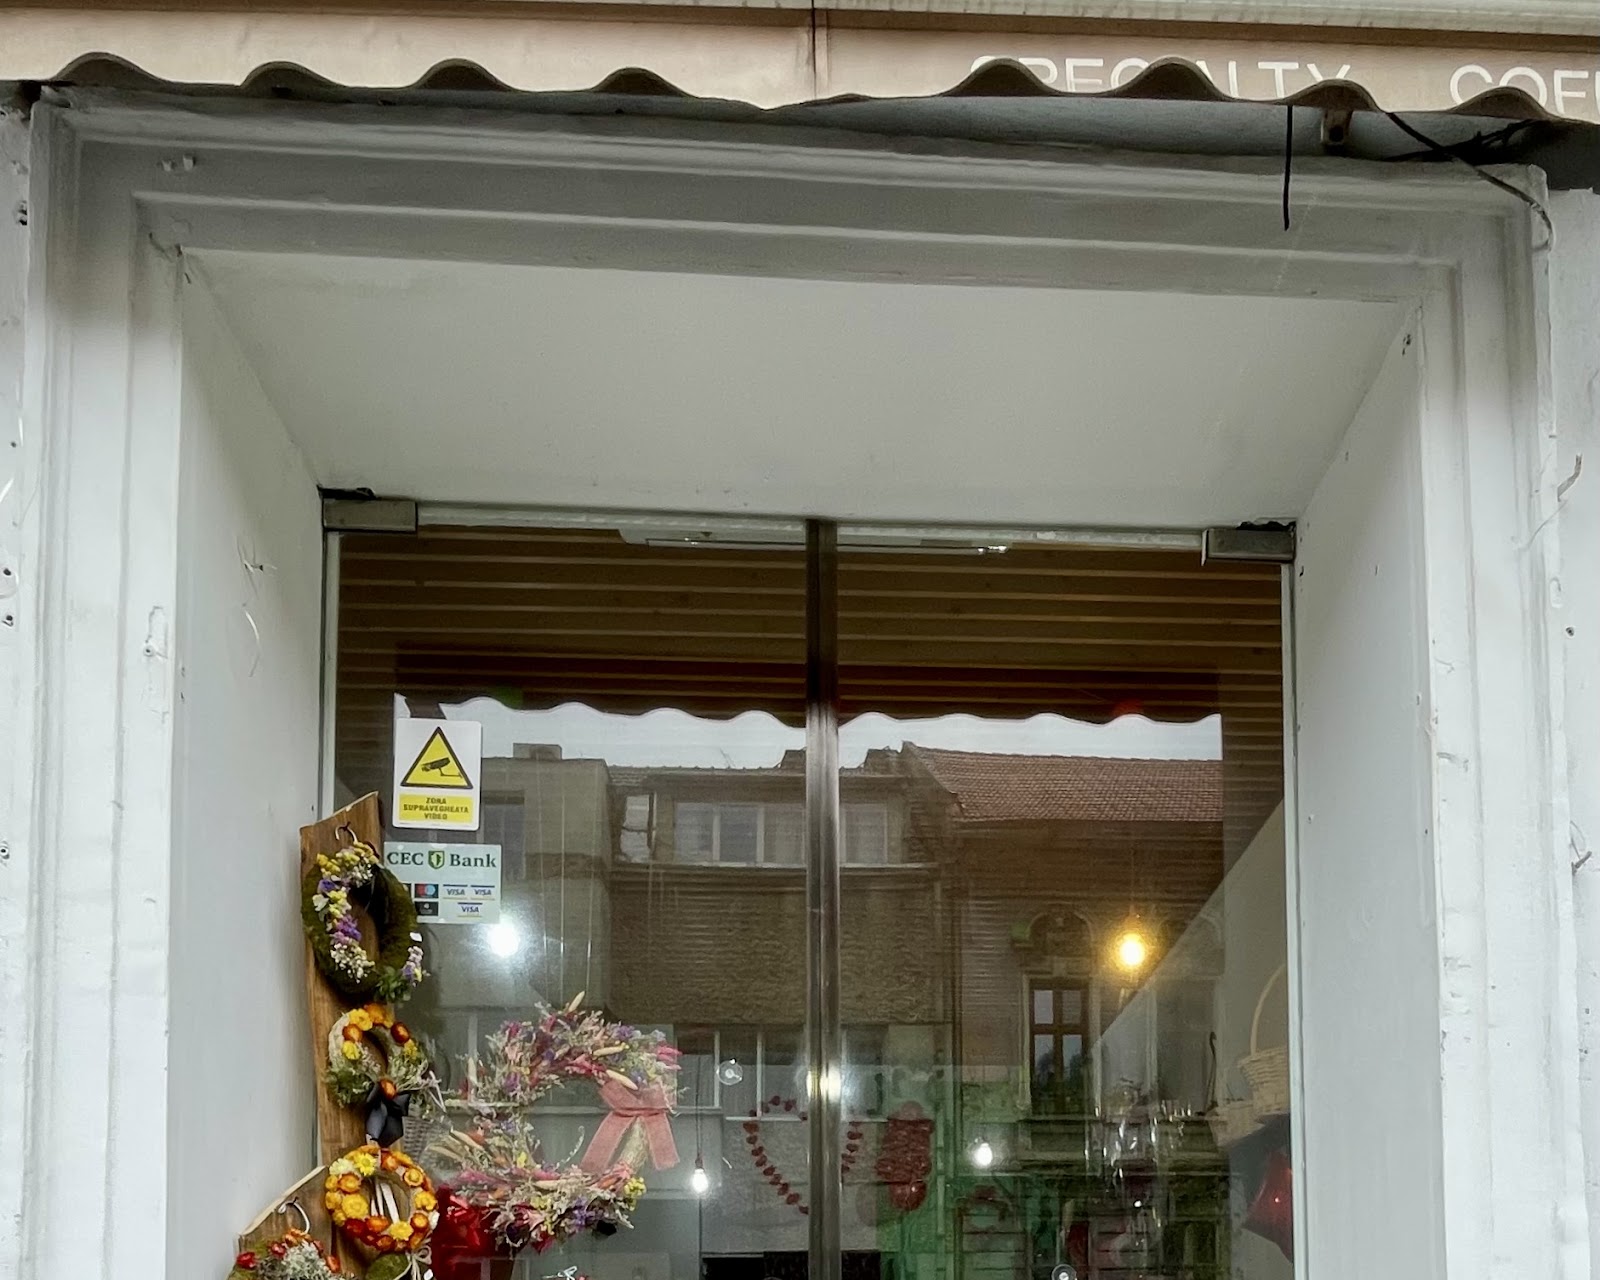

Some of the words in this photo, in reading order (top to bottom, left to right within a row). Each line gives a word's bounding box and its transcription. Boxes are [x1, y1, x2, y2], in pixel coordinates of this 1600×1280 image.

[1449, 64, 1600, 118] COF
[424, 812, 448, 820] VIDEO
[387, 851, 424, 865] CEC
[450, 853, 497, 868] Bank
[447, 888, 466, 896] VISA
